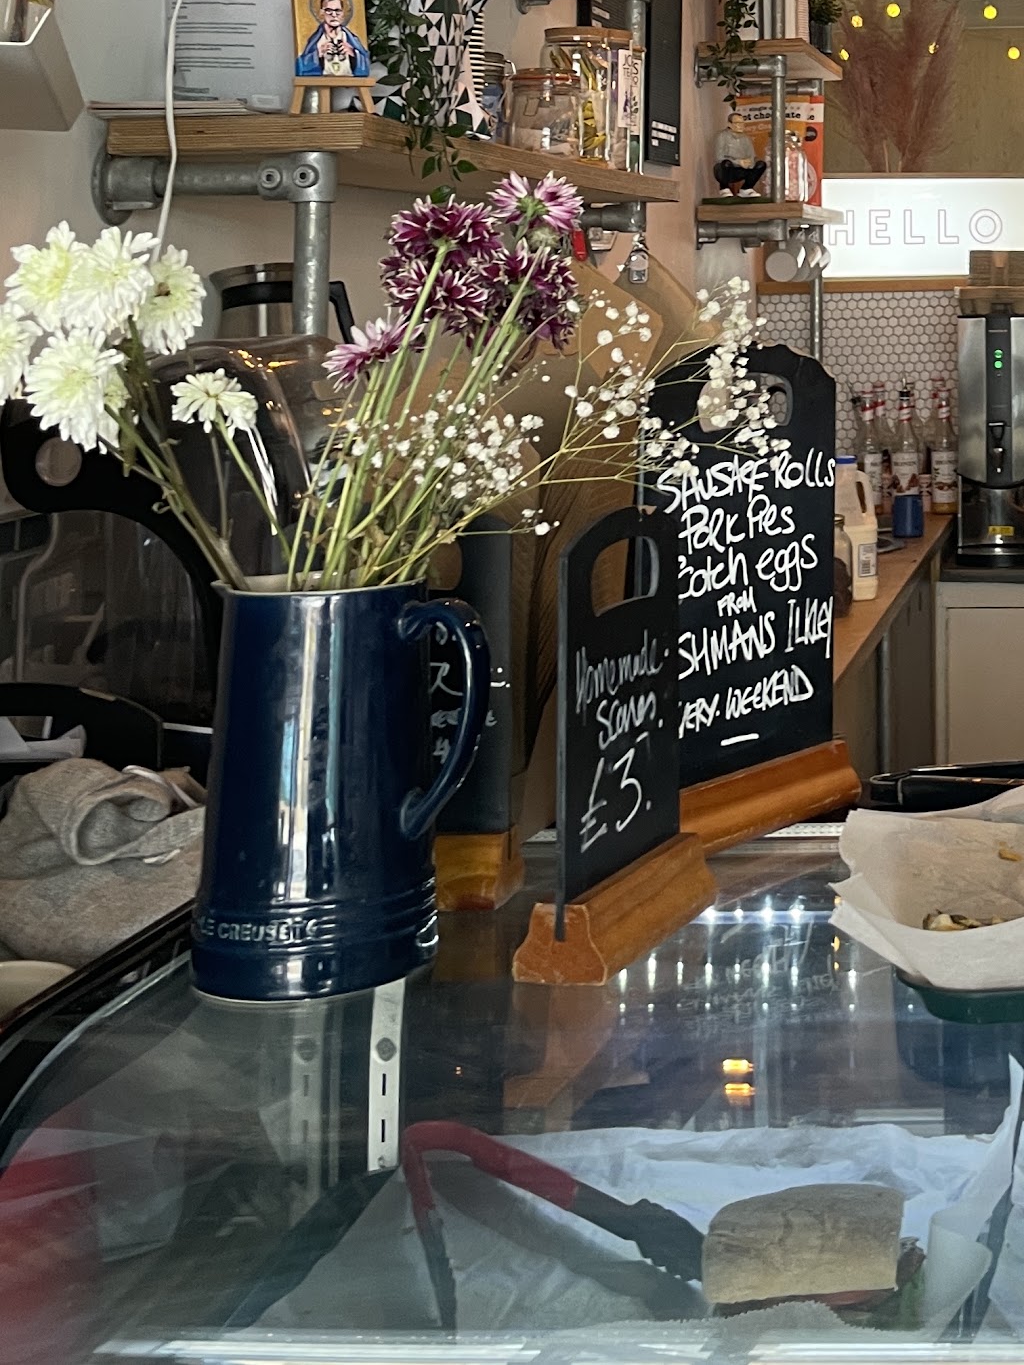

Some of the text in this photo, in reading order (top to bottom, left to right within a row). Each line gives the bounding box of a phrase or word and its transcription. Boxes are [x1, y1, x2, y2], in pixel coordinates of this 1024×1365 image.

[753, 111, 802, 122] choate
[828, 208, 1003, 246] HELLO
[755, 533, 819, 593] eggs
[678, 611, 776, 681] SHMANS
[725, 664, 815, 721] WEEKEND
